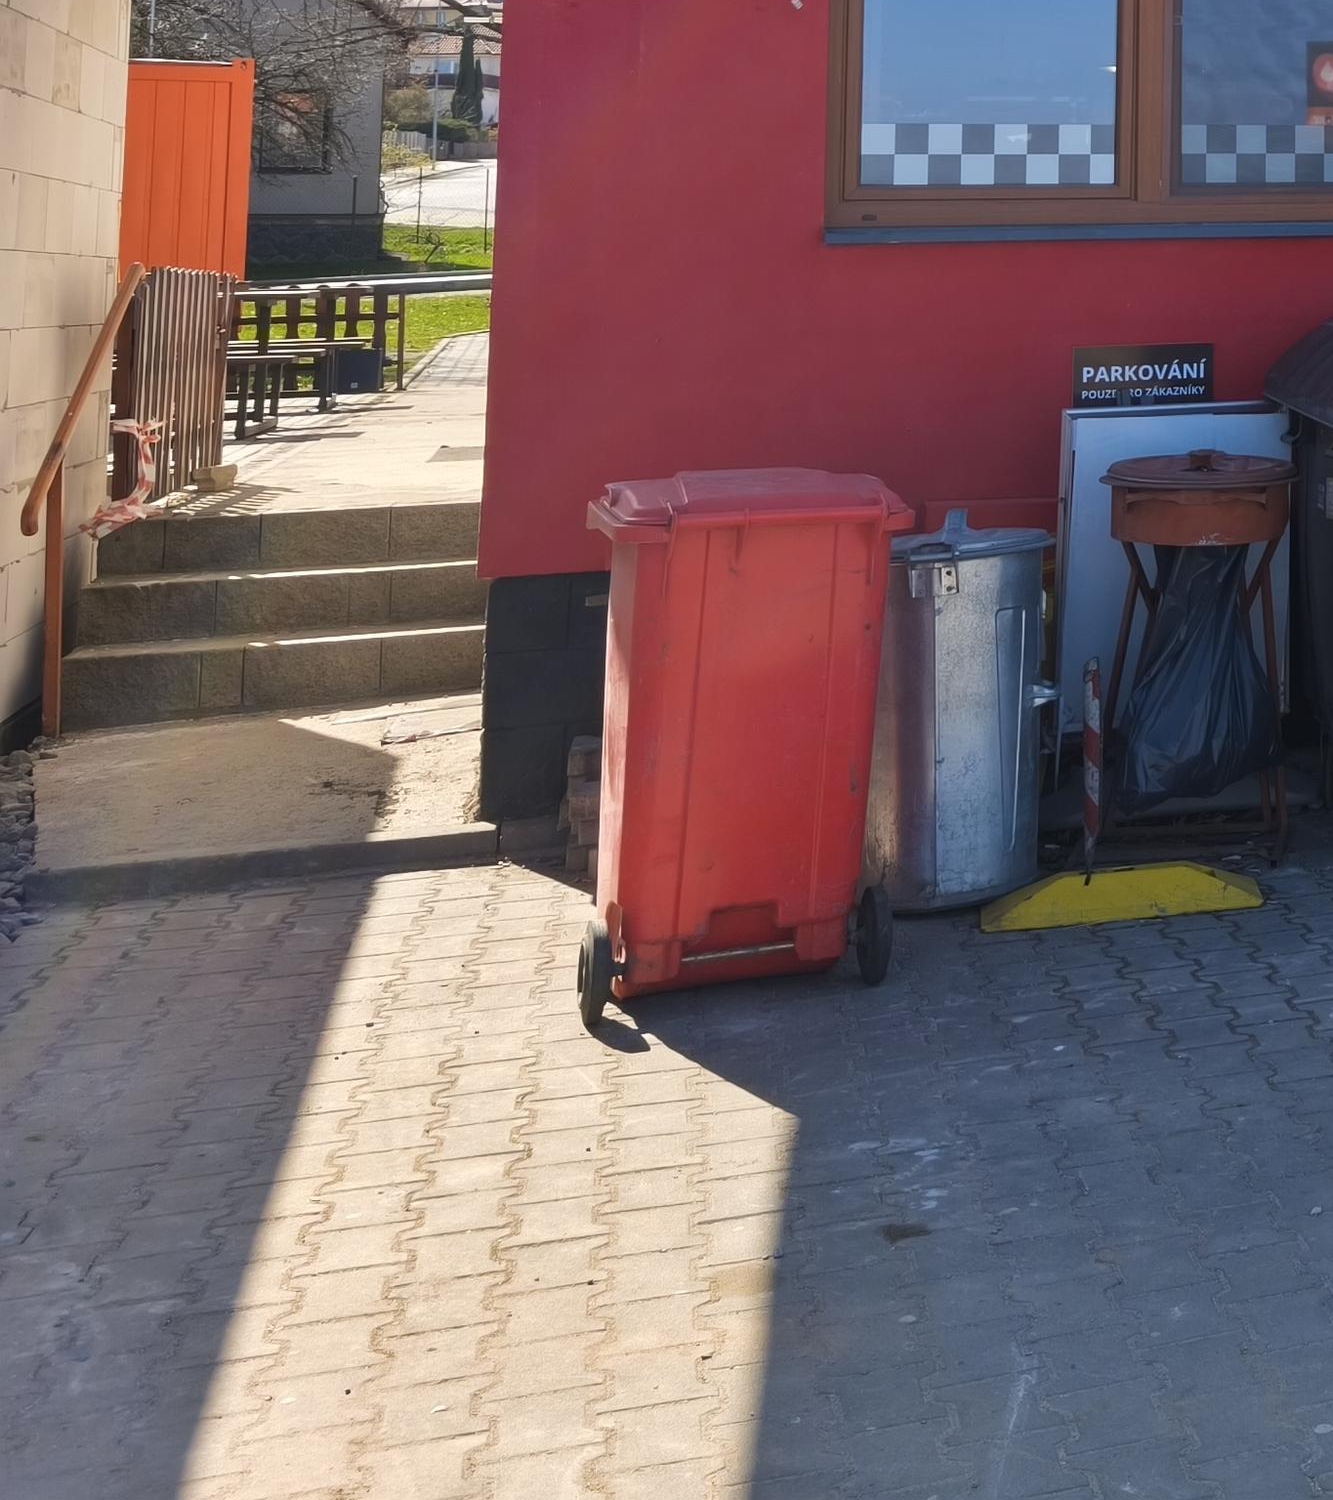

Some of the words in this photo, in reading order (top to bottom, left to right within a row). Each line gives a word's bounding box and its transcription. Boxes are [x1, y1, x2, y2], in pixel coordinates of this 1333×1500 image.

[1082, 358, 1207, 383] PARKOVÁNÍ
[1081, 389, 1117, 400] POUZE
[1145, 384, 1205, 397] ZÁKAZNÍKY
